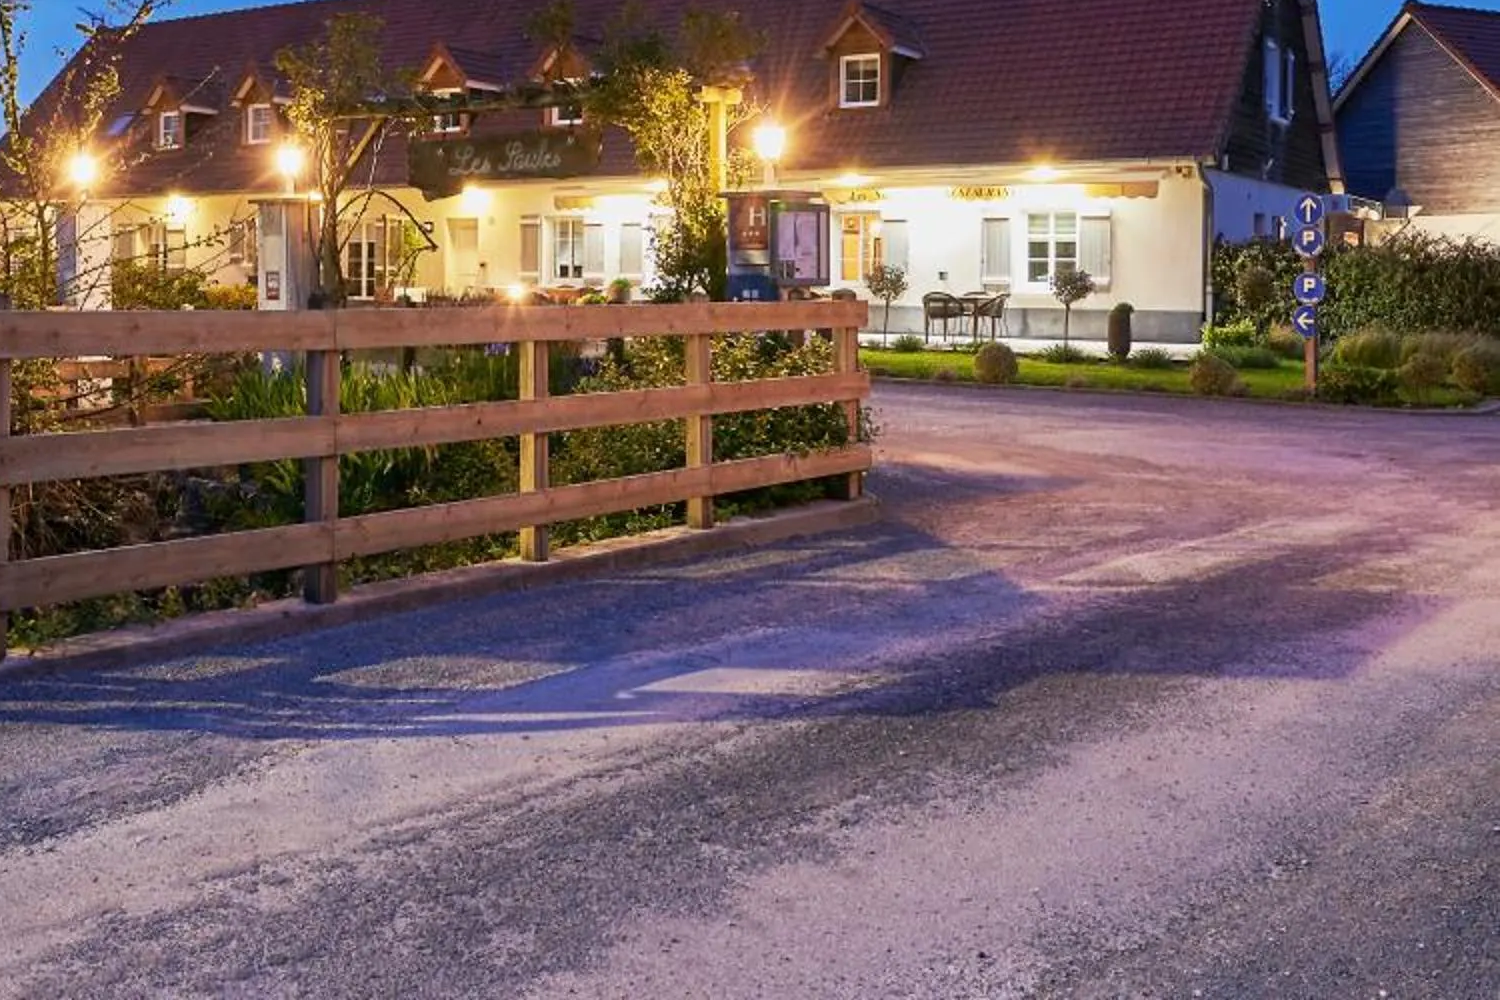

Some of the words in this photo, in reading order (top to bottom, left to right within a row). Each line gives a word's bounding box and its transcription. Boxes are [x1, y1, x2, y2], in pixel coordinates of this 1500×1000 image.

[448, 145, 491, 175] Les
[498, 138, 562, 171] Saules
[1303, 231, 1315, 246] P
[1303, 278, 1316, 293] P
